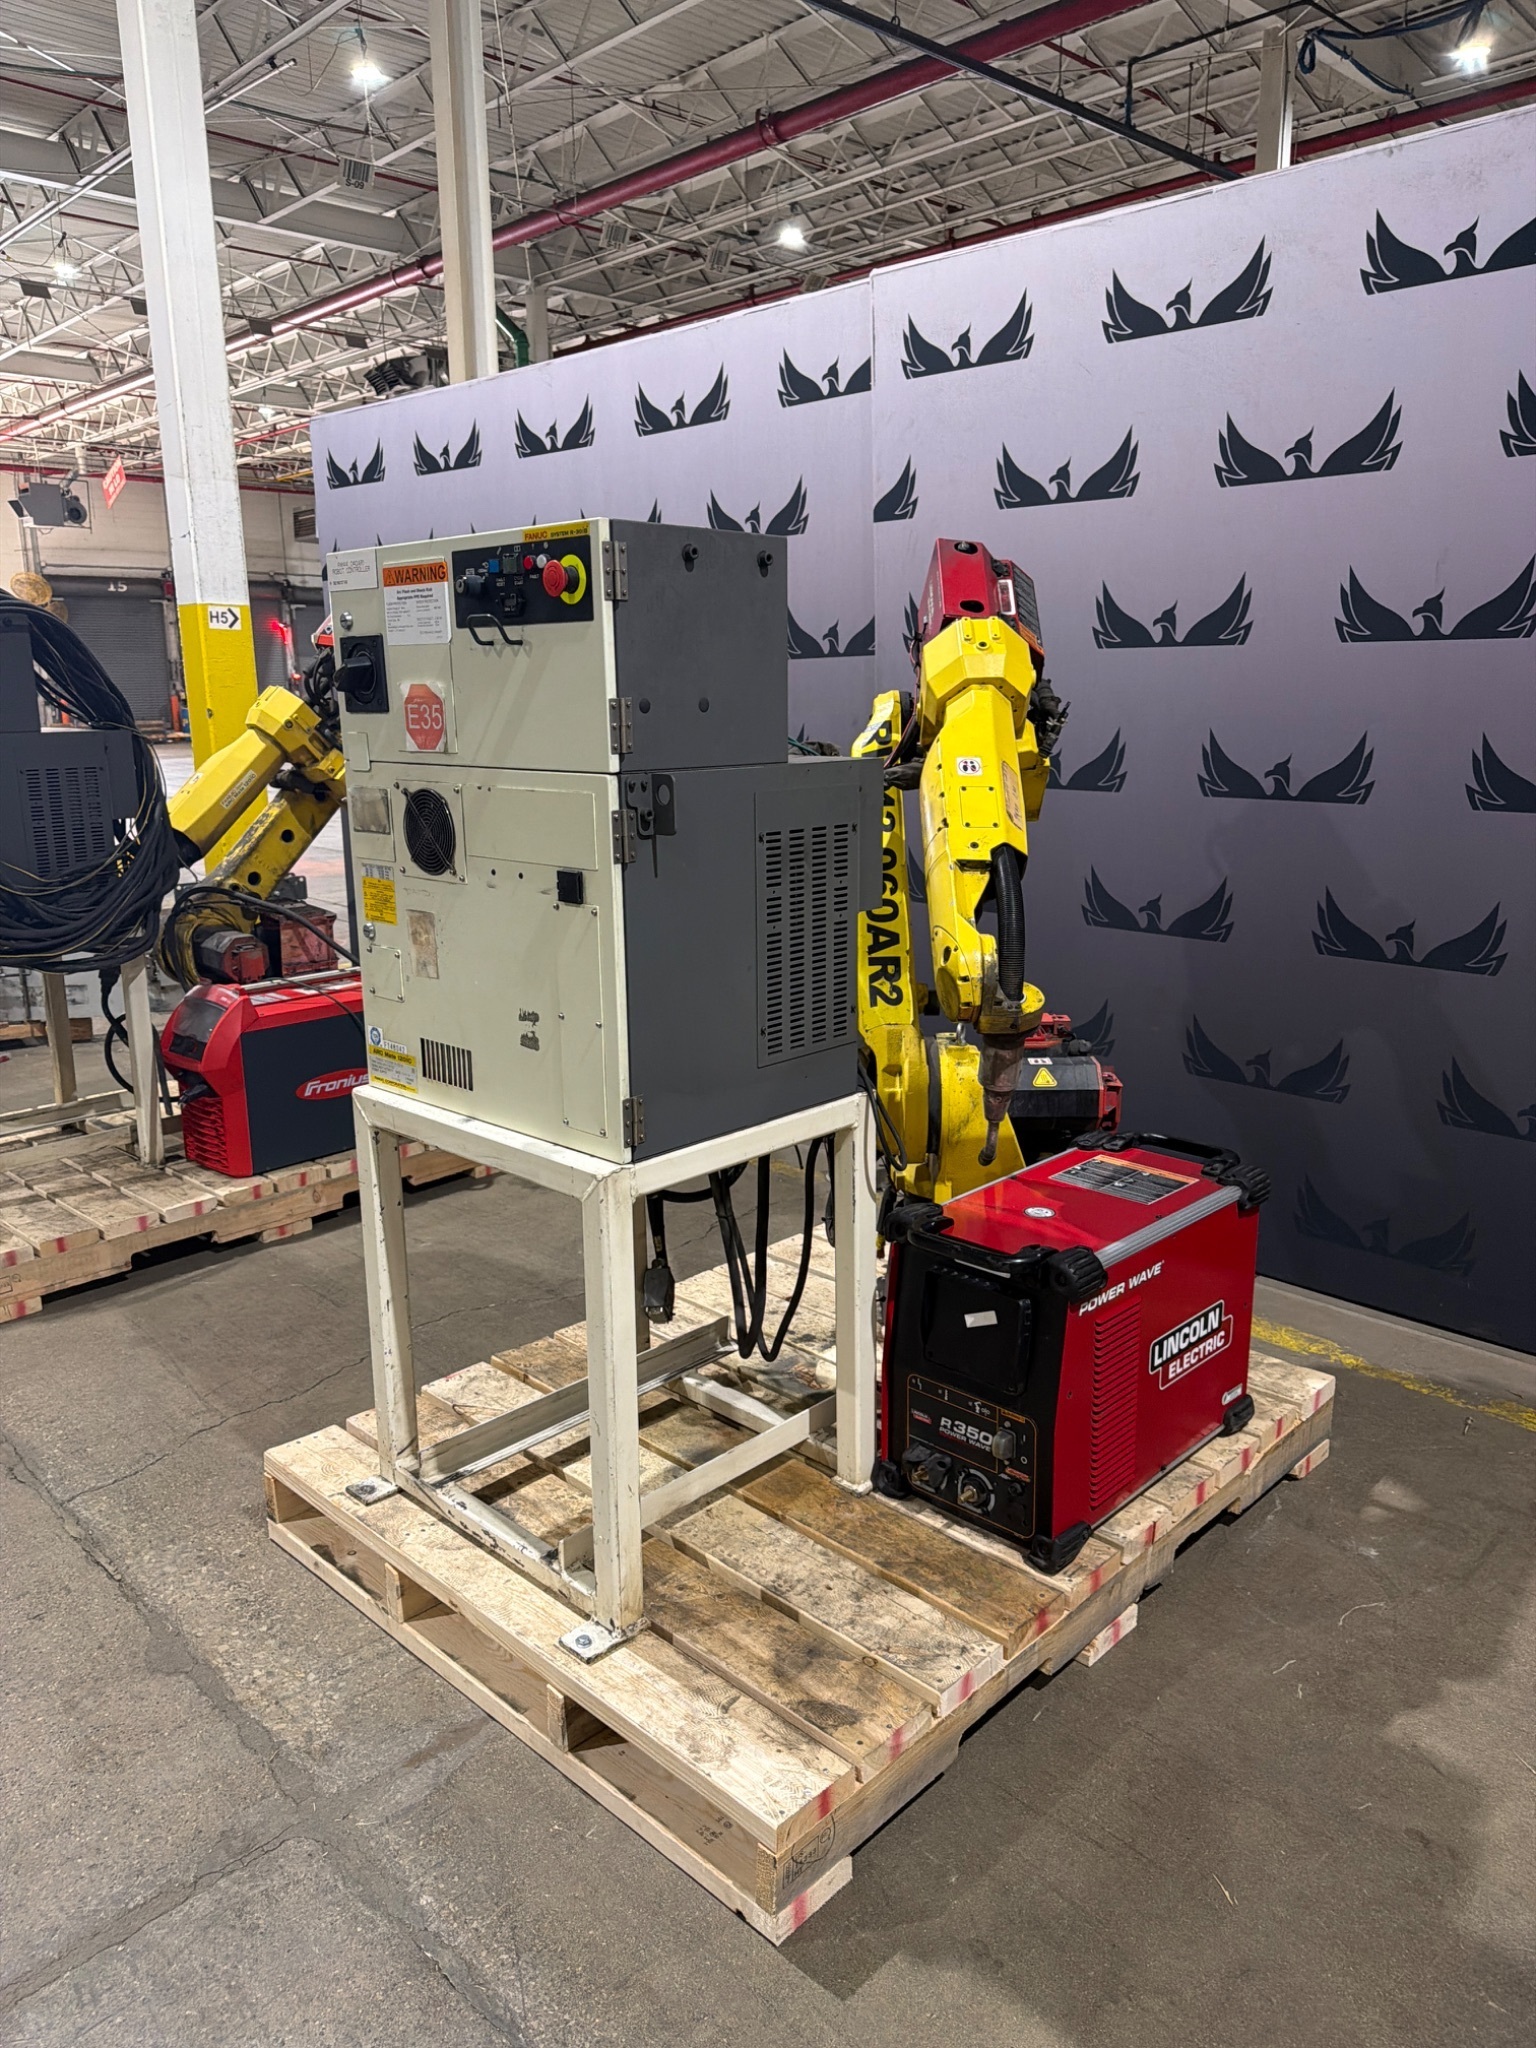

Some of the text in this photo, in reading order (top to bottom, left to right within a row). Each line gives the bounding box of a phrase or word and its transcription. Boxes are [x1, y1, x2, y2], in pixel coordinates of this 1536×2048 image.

[345, 178, 365, 190] S-09
[524, 530, 548, 541] FANUC
[550, 530, 569, 538] SYSTEM
[394, 564, 446, 584] WARNING
[209, 610, 229, 624] H5
[407, 703, 442, 730] E35
[373, 1048, 384, 1056] ARC
[384, 1050, 397, 1060] Mate
[304, 1073, 369, 1097] Fronius
[1078, 1261, 1163, 1316] POWER WAVE
[1153, 1307, 1221, 1367] LINCOLN
[1168, 1330, 1226, 1380] ELECTRIC
[939, 1427, 992, 1453] POWER WAVE
[940, 1416, 993, 1446] R350
